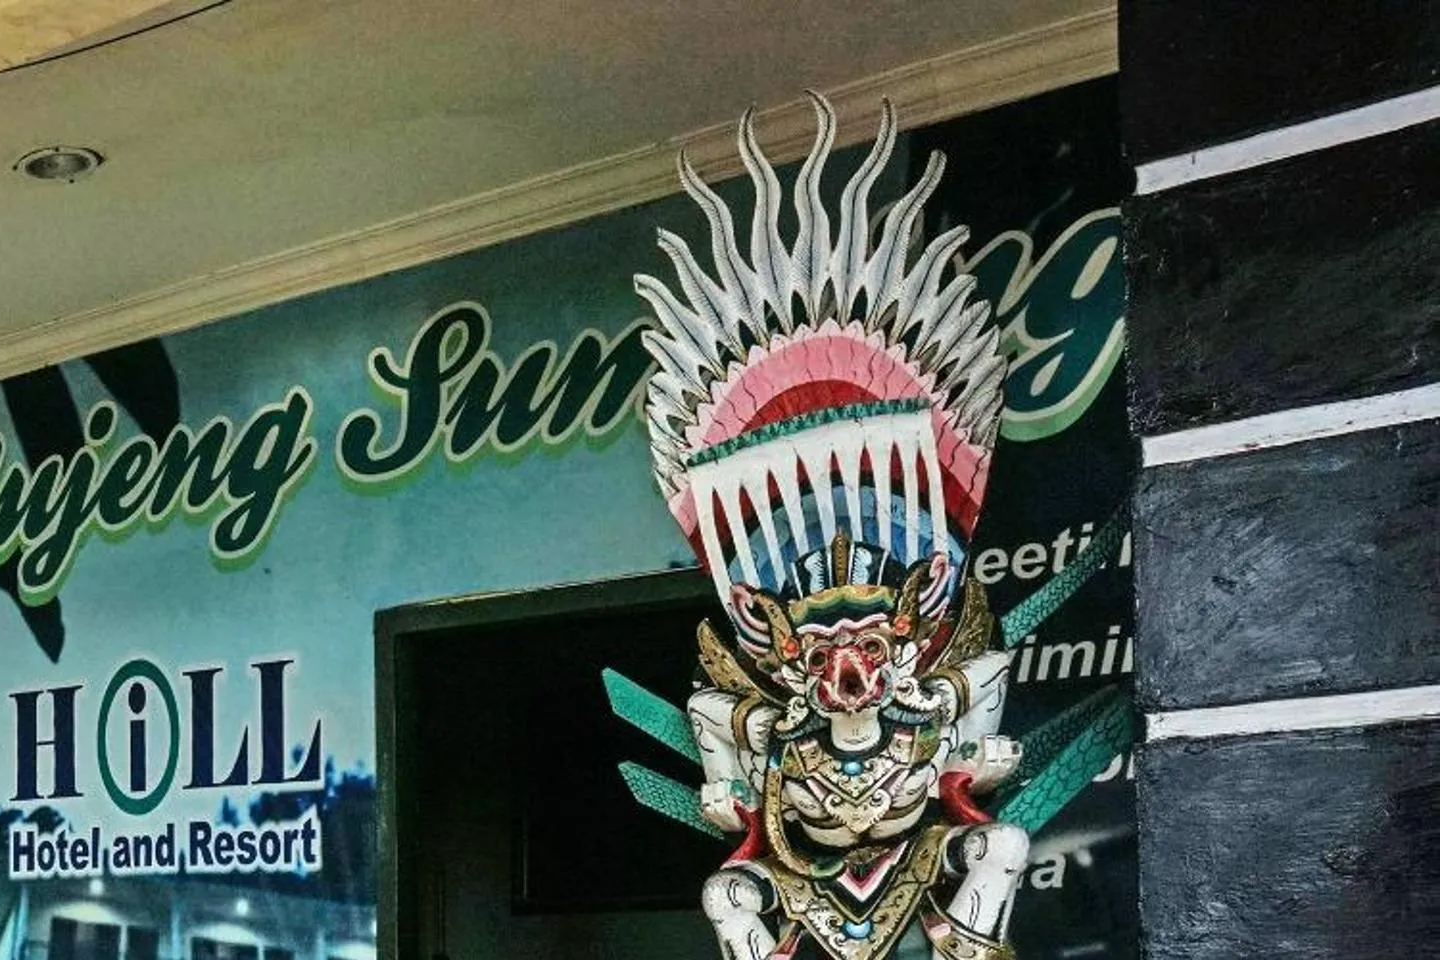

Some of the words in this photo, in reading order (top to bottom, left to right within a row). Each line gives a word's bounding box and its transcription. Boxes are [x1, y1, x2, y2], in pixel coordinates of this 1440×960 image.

[967, 521, 1133, 585] eeti
[11, 825, 100, 874] Hotel
[111, 822, 176, 869] and
[188, 817, 318, 867] Resort
